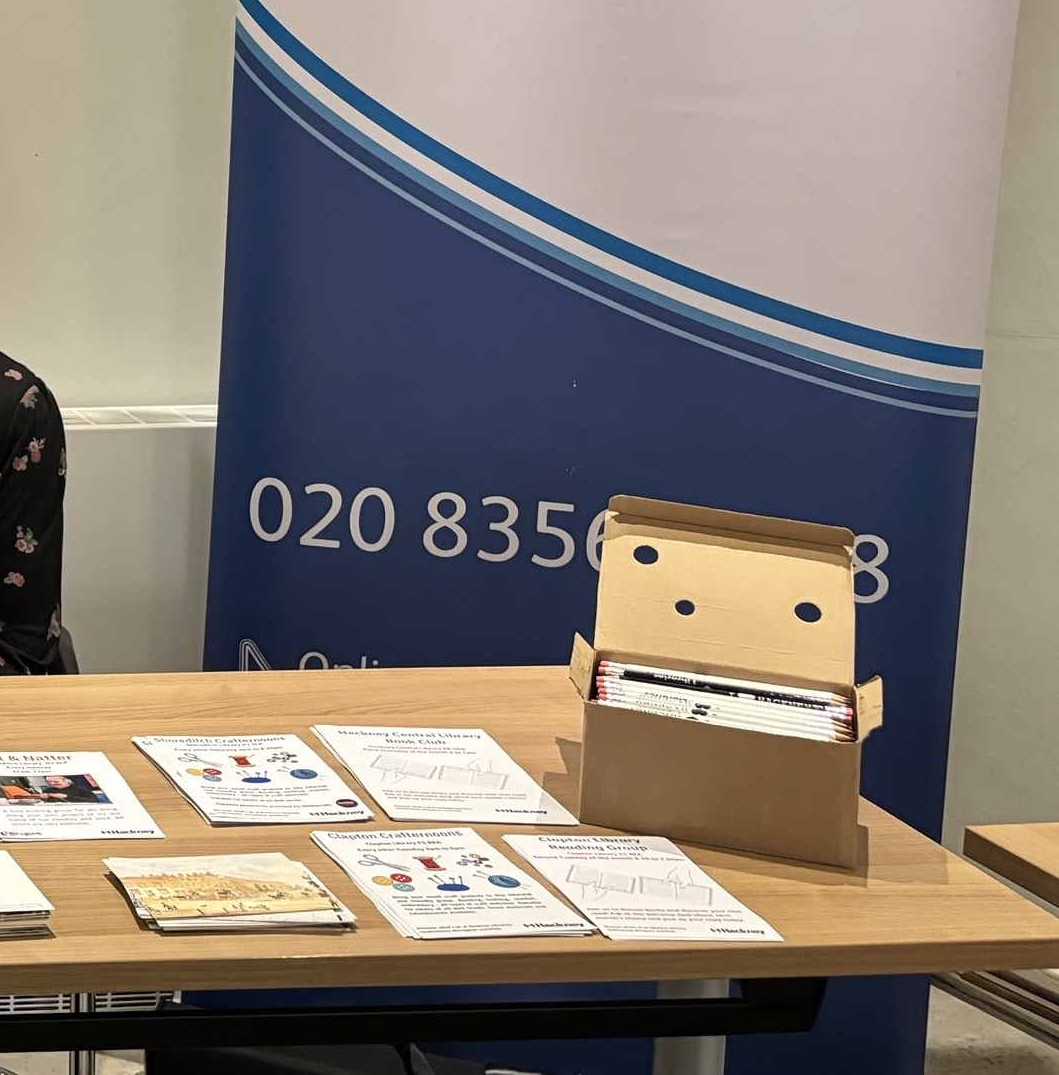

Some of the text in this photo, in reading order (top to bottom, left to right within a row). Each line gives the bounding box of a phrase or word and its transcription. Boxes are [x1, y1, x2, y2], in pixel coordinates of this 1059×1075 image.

[249, 477, 396, 552] 020
[328, 830, 463, 840] Clapton Crafternoons
[539, 836, 590, 844] Clapton
